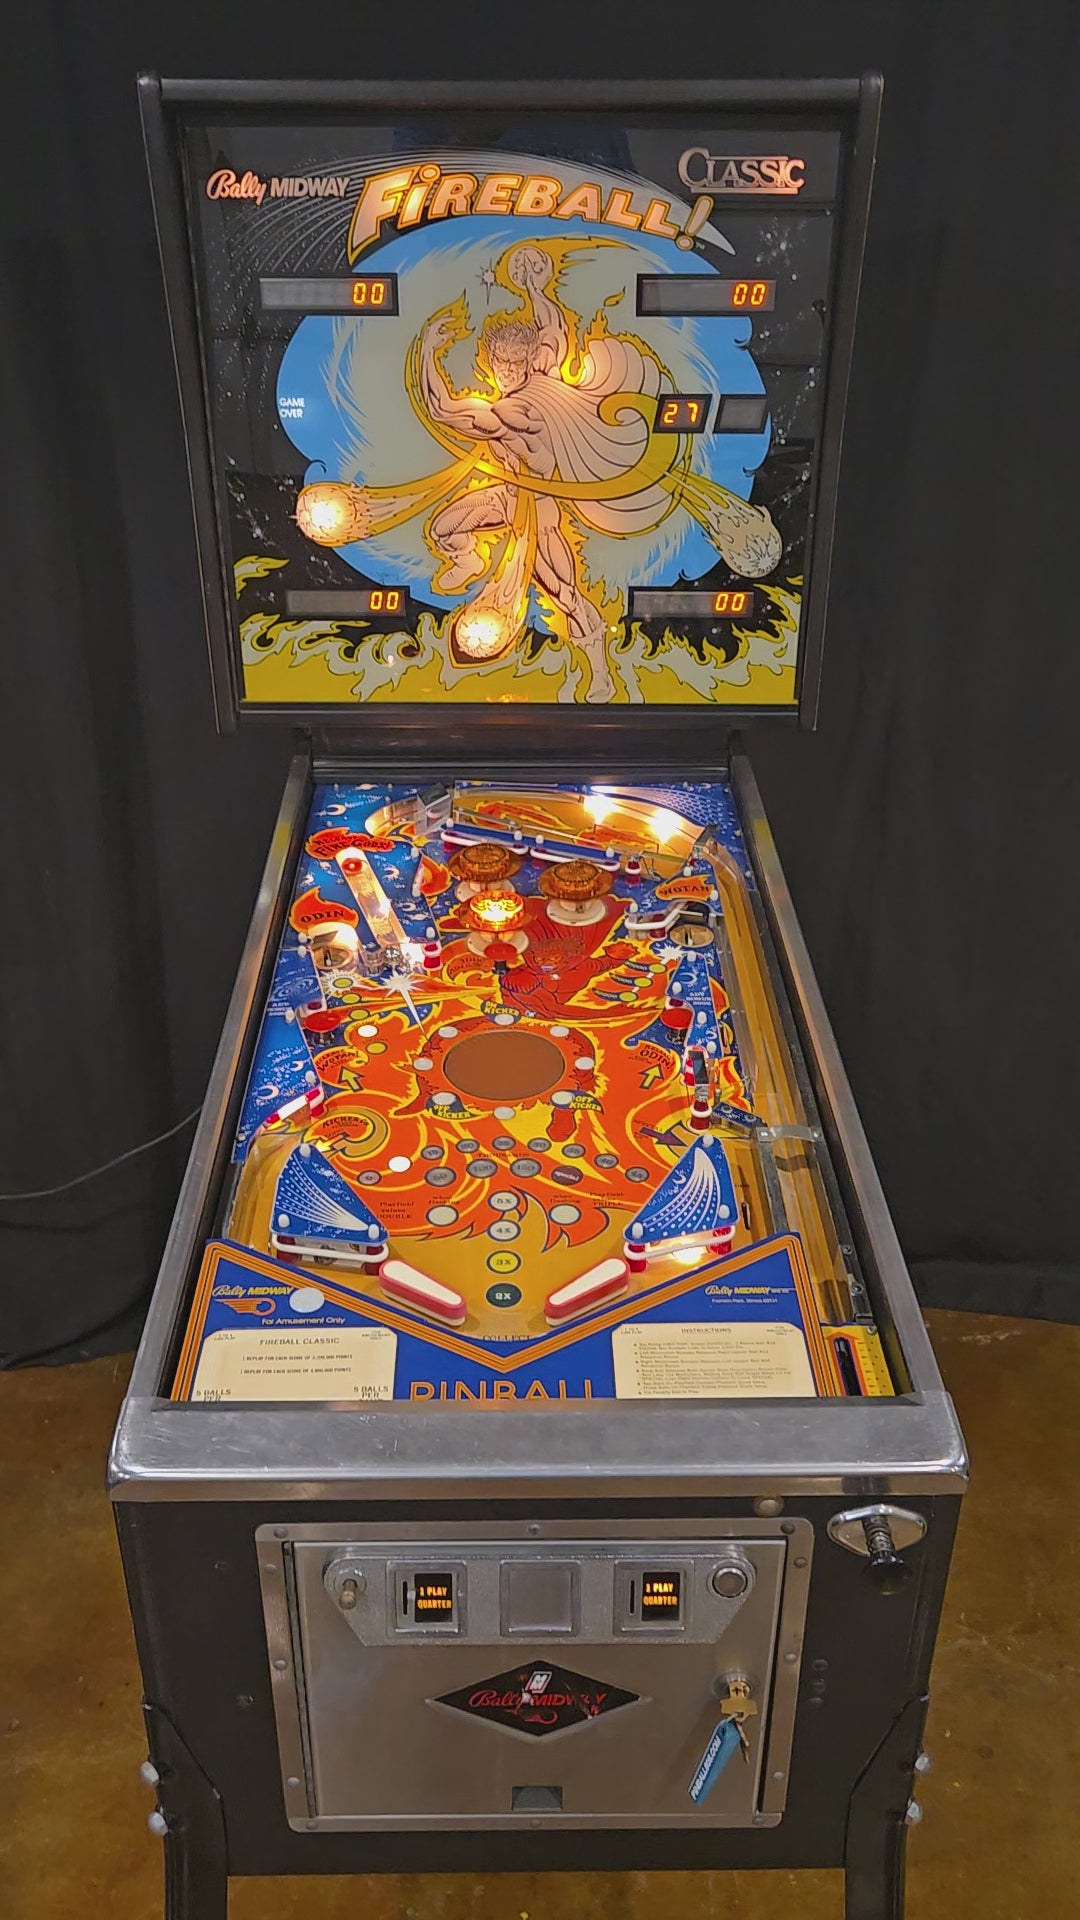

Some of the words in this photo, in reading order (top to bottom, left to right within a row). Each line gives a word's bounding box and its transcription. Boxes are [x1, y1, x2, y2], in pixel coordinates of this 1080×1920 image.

[677, 146, 806, 192] CLASSIC
[205, 168, 267, 206] Bally
[269, 176, 351, 199] MIDWAY
[351, 282, 386, 306] 00
[731, 282, 768, 307] 00
[279, 397, 306, 408] GAME
[279, 408, 304, 419] OVER
[662, 402, 701, 424] 27
[369, 591, 400, 611] 00
[714, 592, 746, 612] 00
[300, 910, 345, 923] ODIN
[484, 1005, 520, 1017] KICKER
[575, 1095, 594, 1103] OFF
[433, 1104, 450, 1112] OFF
[569, 1101, 602, 1112] KICKER
[437, 1110, 472, 1120] KICKER
[211, 1284, 246, 1299] Bally
[247, 1286, 295, 1297] MIDWAY
[261, 1317, 275, 1326] For
[275, 1316, 325, 1326] Amusement
[325, 1316, 346, 1325] Only
[259, 1338, 301, 1346] FIREBALL
[302, 1337, 341, 1345] CLASSIC
[202, 1388, 232, 1396] BALLS
[361, 1385, 389, 1393] BALLS
[418, 1587, 425, 1597] 1
[426, 1586, 448, 1597] PLAY
[645, 1583, 651, 1593] 1
[652, 1582, 674, 1593] PLAY
[417, 1599, 452, 1609] QUARTER
[642, 1595, 678, 1606] QUARTER
